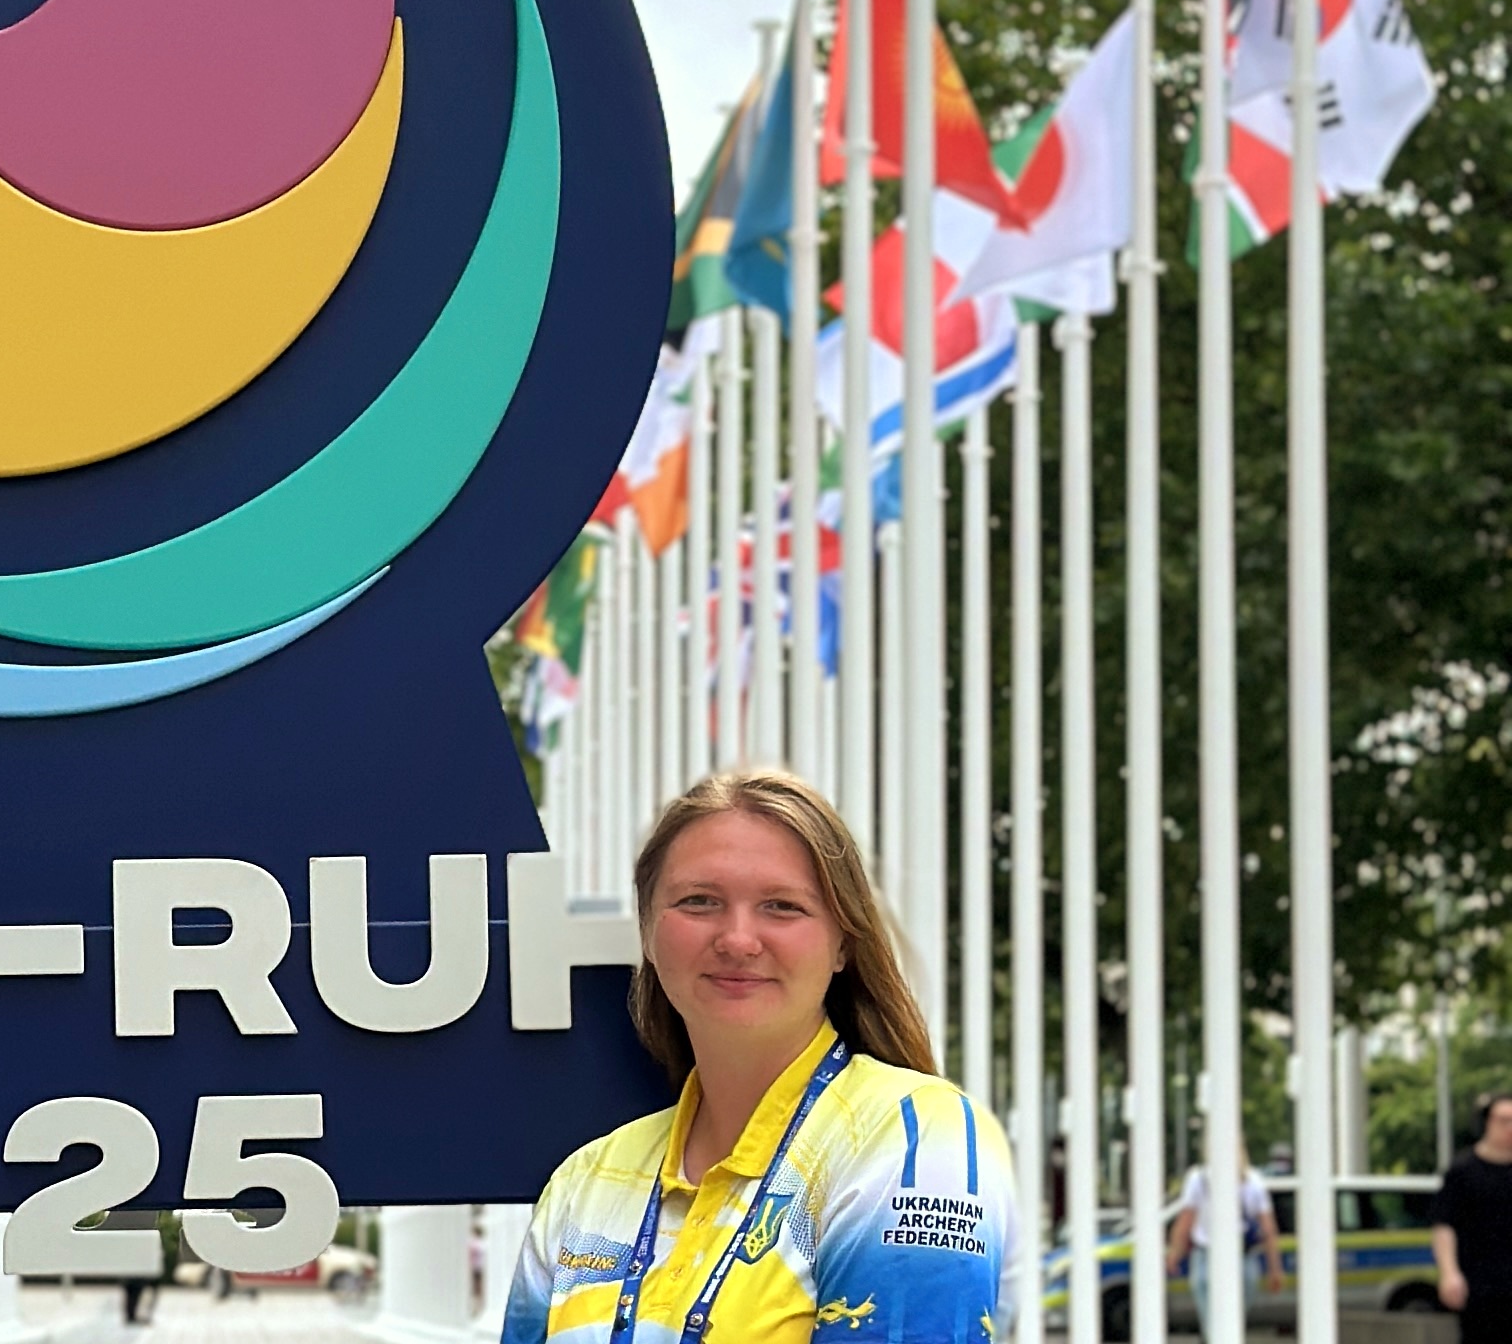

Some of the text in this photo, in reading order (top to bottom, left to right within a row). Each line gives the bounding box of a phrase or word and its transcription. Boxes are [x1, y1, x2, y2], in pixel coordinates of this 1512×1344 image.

[892, 1196, 983, 1220] UKRAINIAN
[898, 1214, 976, 1234] ARCHERY
[883, 1230, 986, 1254] FEDERATION
